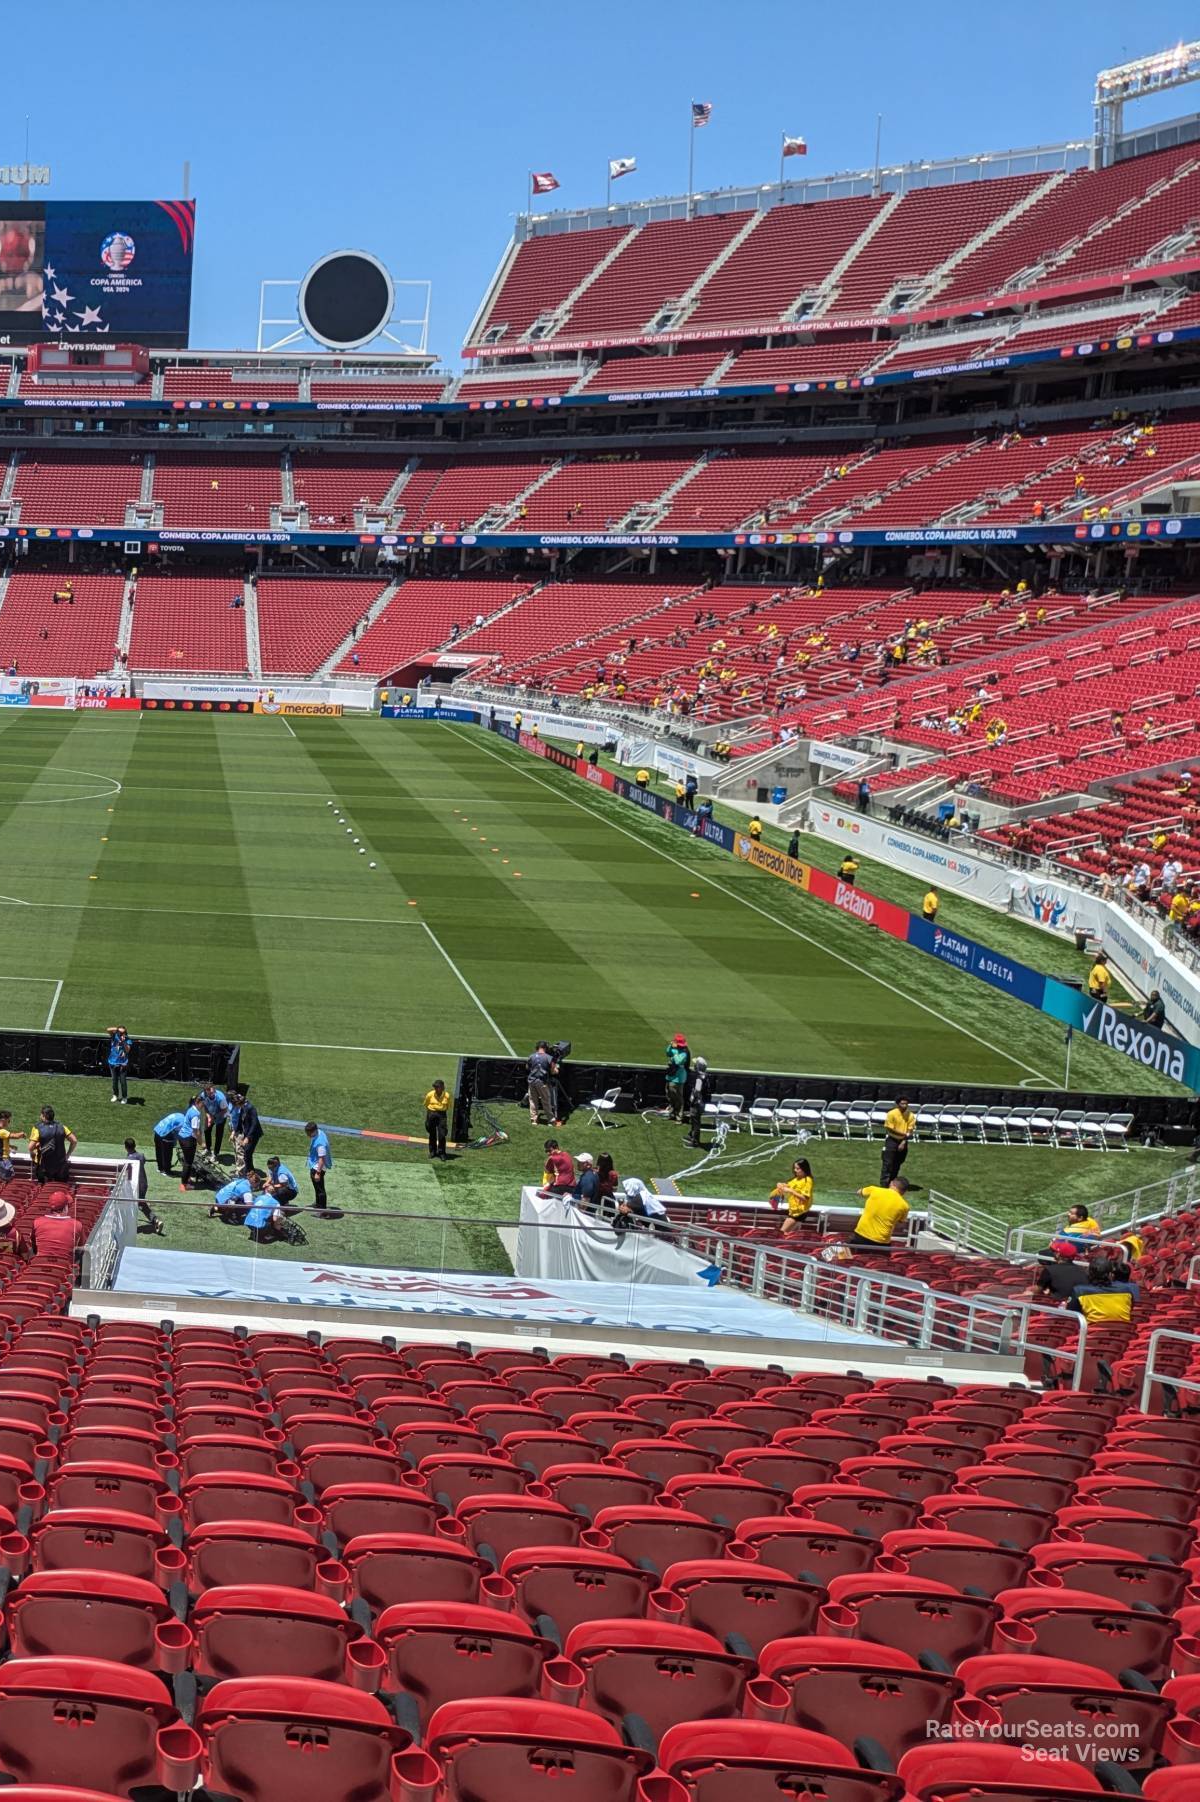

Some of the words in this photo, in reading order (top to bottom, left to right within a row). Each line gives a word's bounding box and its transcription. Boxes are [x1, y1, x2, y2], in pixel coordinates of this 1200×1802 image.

[729, 327, 758, 336] INCLUDE
[832, 319, 849, 328] AND
[913, 367, 942, 378] CONMEBOL
[942, 366, 957, 374] COPA
[957, 362, 982, 373] AMERICA
[608, 393, 642, 401] CONMEBOL
[159, 531, 200, 539] CONMEBOL
[201, 532, 220, 540] COPA
[220, 532, 255, 540] AMERICA
[256, 533, 271, 541] USA
[272, 533, 290, 541] 2024
[540, 536, 583, 544] CONMEBOL
[583, 536, 604, 544] COPA
[604, 536, 640, 544] AMERICA
[884, 531, 924, 541] CONMEBOL
[925, 531, 944, 540] COPA
[945, 530, 979, 540] AMERICA
[981, 529, 996, 539] USA
[997, 528, 1017, 539] 2024
[284, 705, 330, 714] mercado
[629, 787, 642, 800] SANTA
[643, 793, 656, 810] CLARA
[704, 820, 724, 843] ULTRA
[887, 837, 911, 854] CONMEBOL
[912, 846, 925, 857] COPA
[925, 850, 946, 866] AMERICA
[752, 847, 785, 874] mercado
[785, 861, 803, 883] libre
[834, 883, 874, 921] Betano
[942, 935, 968, 956] LATAM
[940, 950, 967, 968] AIRLINES
[986, 961, 1012, 983] DELTA
[1162, 979, 1183, 1009] CONMEBOL
[1183, 999, 1193, 1016] COPA
[1098, 1005, 1184, 1082] Rexona
[709, 1211, 737, 1223] 125
